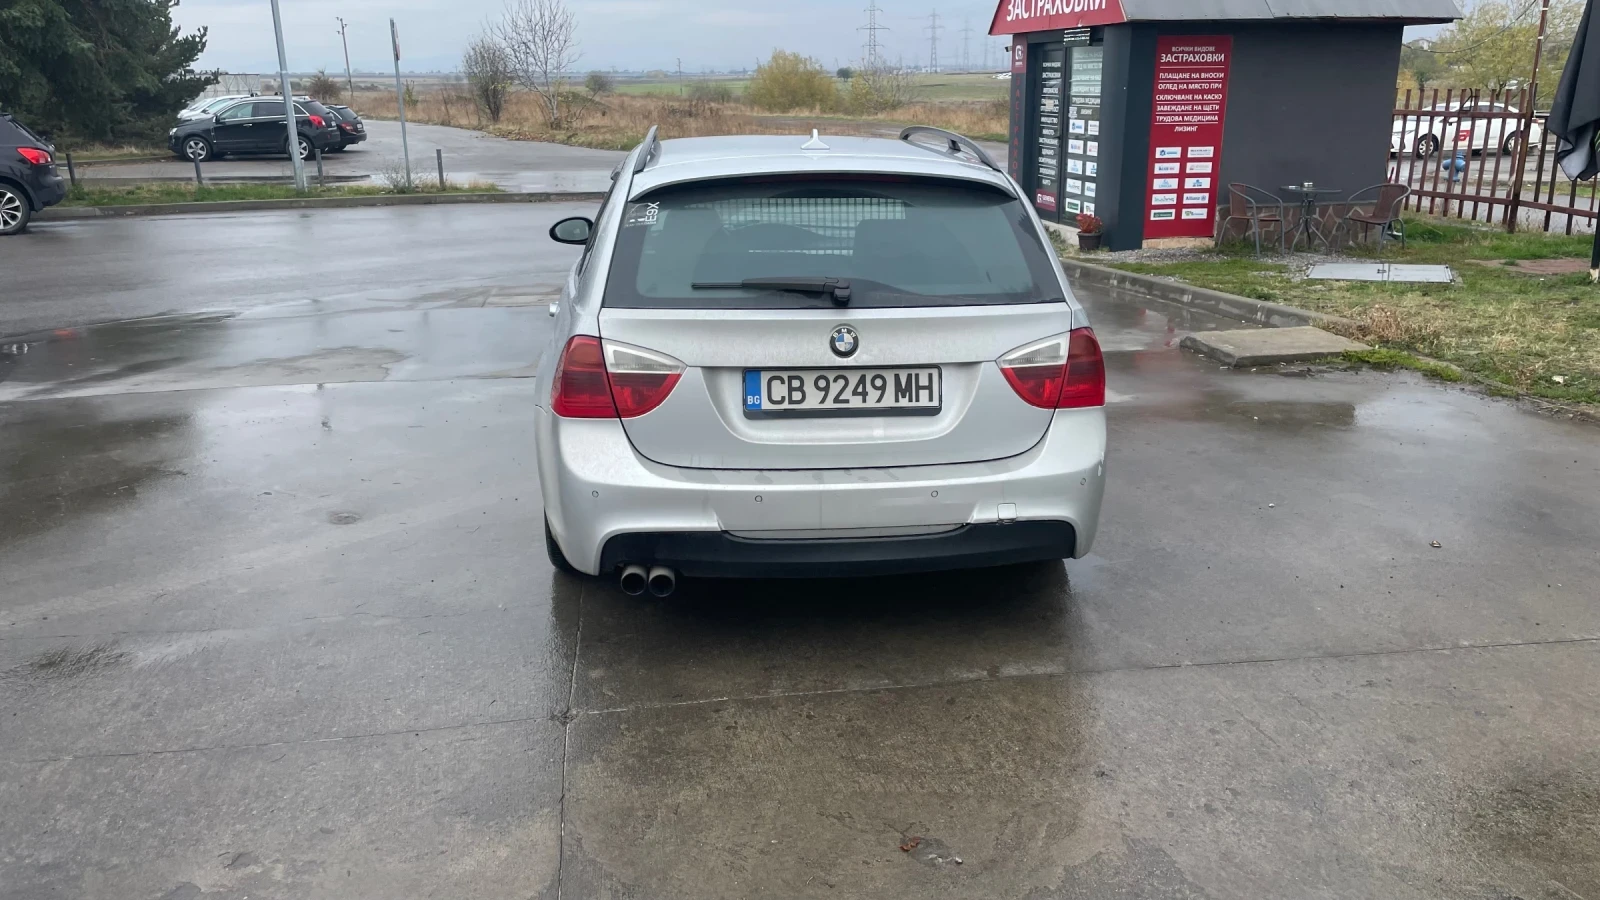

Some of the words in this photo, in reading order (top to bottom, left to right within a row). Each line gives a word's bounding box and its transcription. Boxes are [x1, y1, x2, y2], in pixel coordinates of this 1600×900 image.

[1160, 53, 1225, 62] ЗАСТРАХОВКИ
[747, 395, 760, 405] BG
[766, 375, 807, 405] CB
[813, 374, 887, 404] 9249
[894, 372, 934, 403] MH
